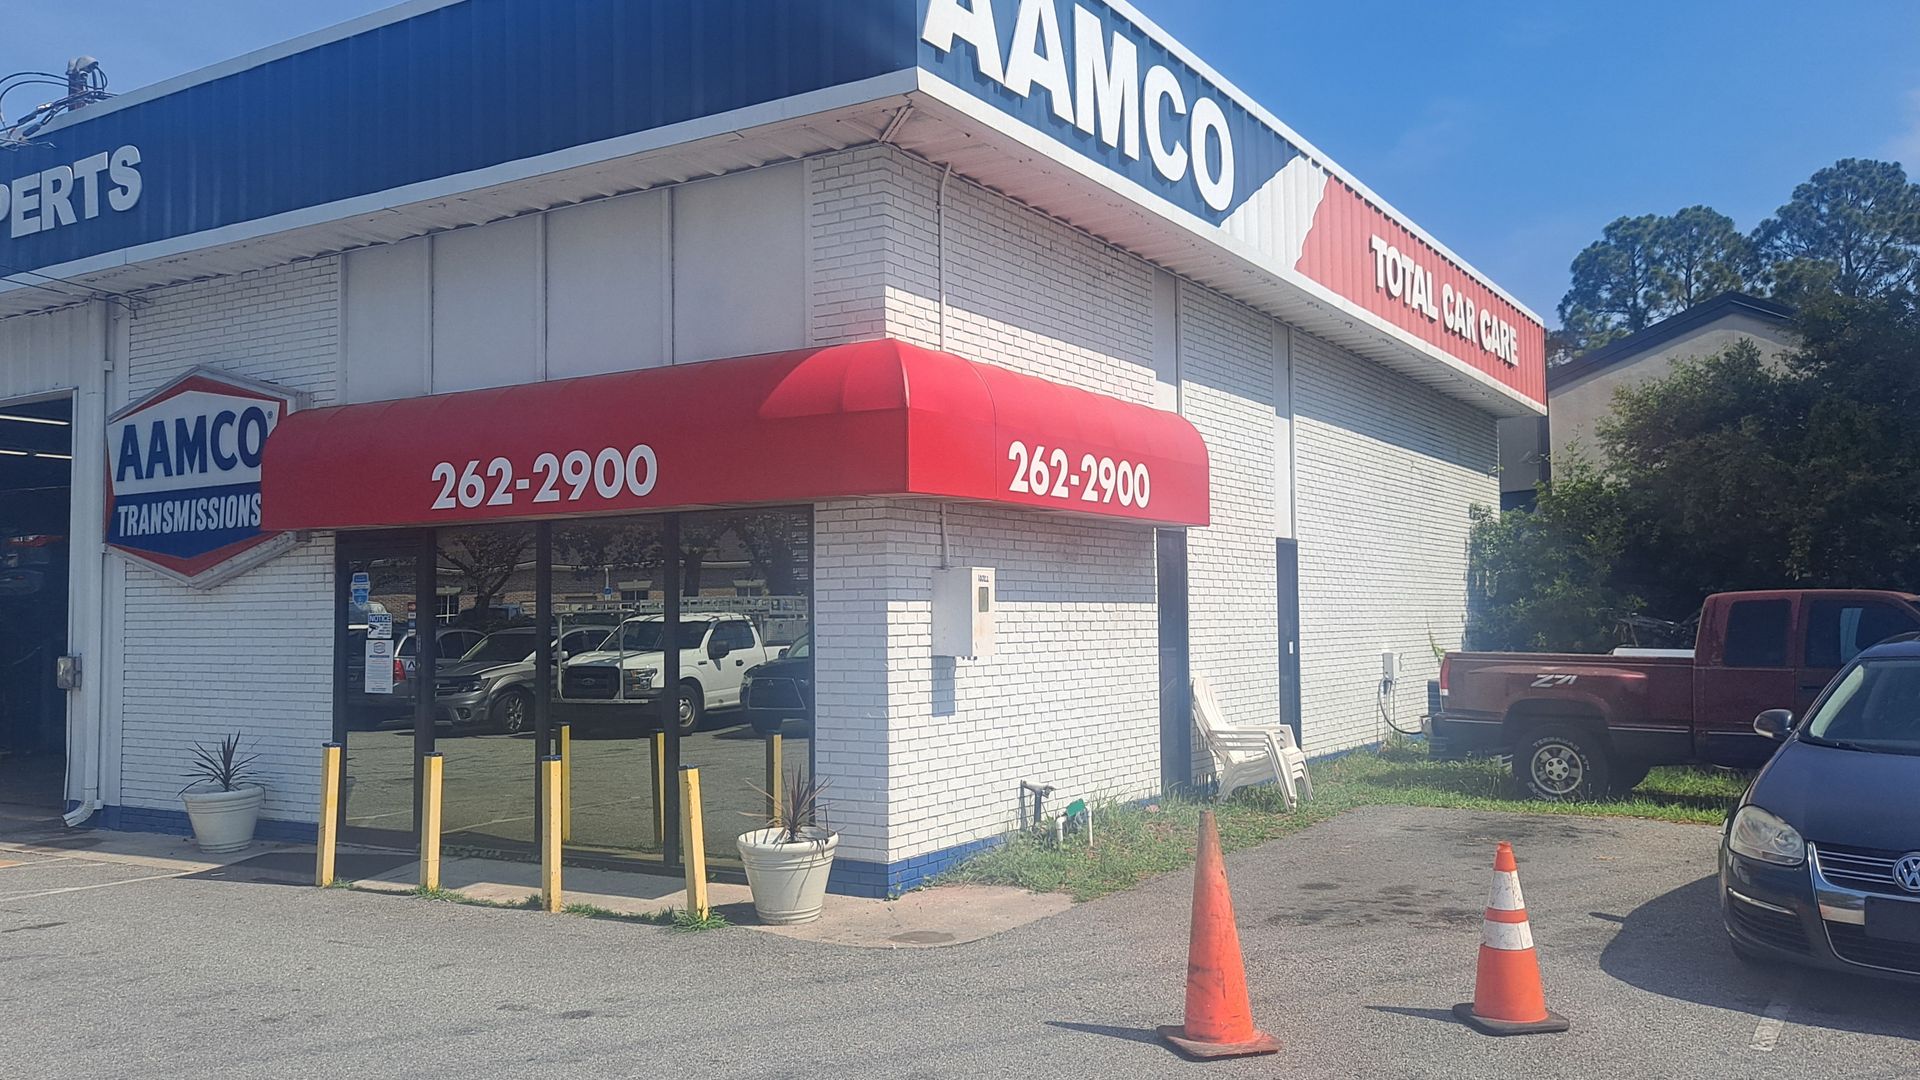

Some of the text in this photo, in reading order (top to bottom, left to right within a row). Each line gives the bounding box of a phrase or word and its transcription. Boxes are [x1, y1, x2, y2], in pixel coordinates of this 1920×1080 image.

[1371, 233, 1519, 367] TOTAL CAR CARE
[116, 406, 268, 481] AAMCO
[431, 444, 658, 510] 262-2900
[1008, 440, 1150, 509] 262-2900
[117, 492, 262, 537] TRANSMISSIONS
[1530, 674, 1578, 688] Z71
